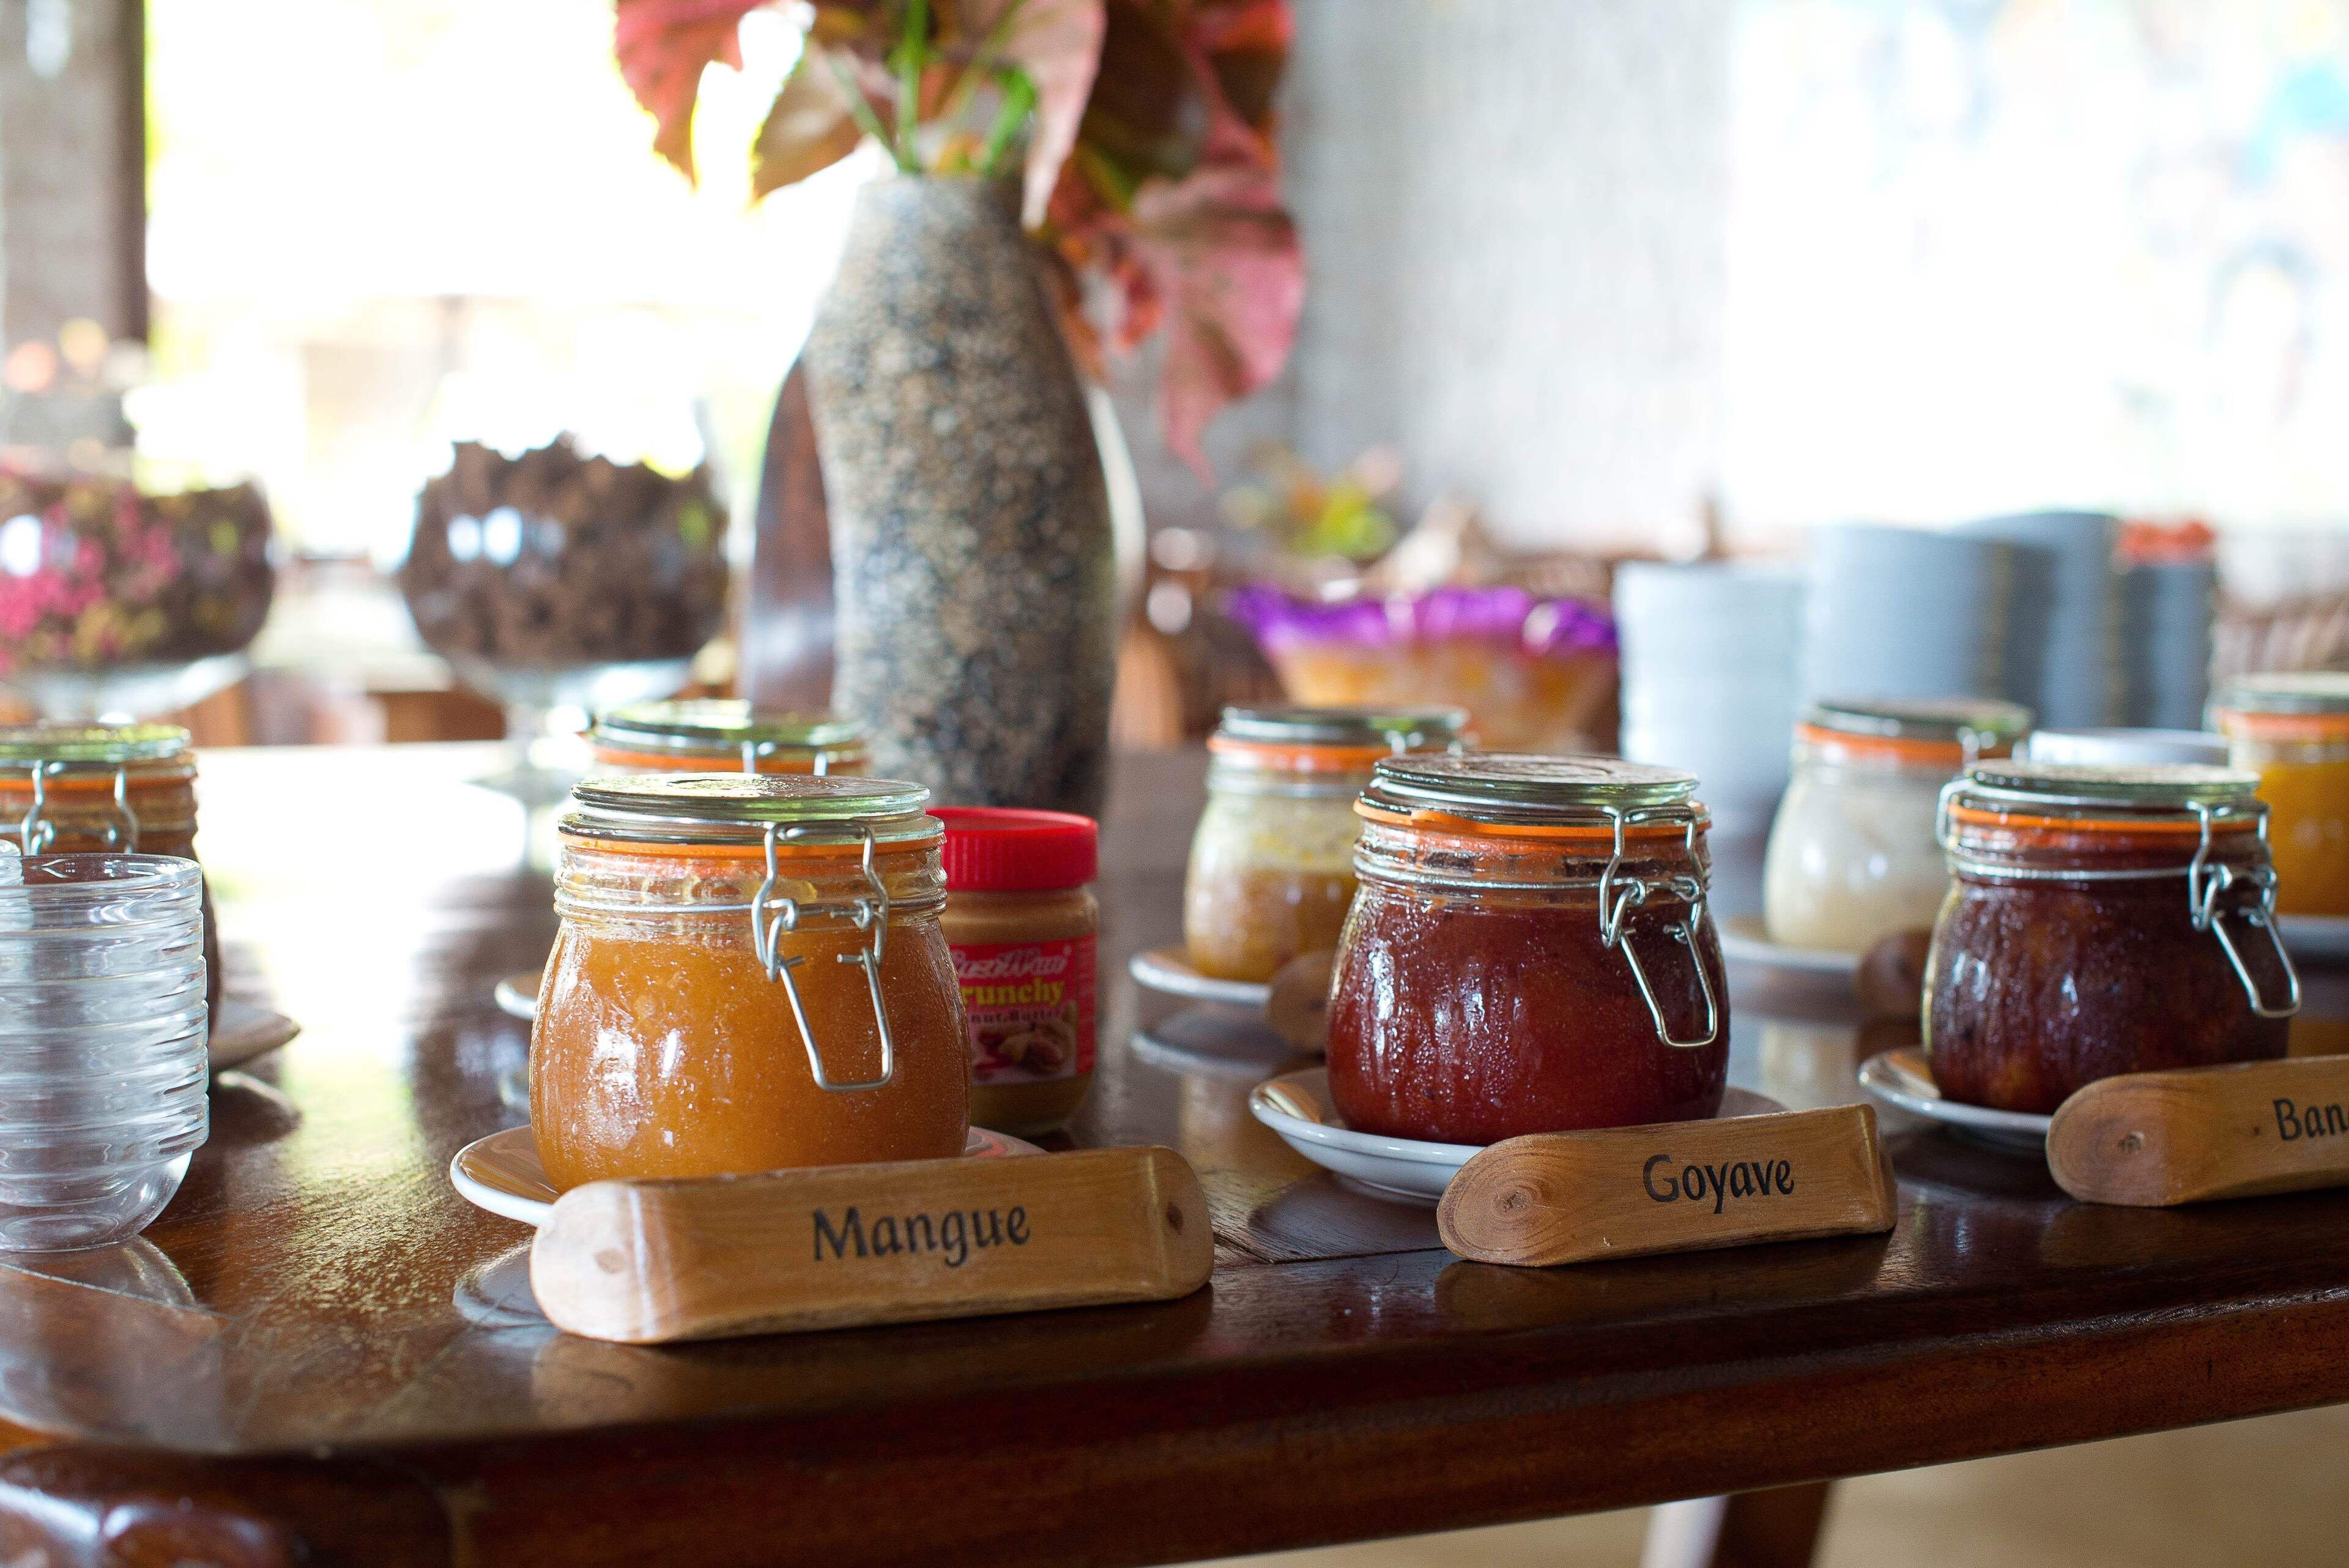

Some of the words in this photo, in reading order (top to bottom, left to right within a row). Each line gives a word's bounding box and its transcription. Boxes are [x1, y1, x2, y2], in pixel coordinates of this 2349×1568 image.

[961, 977, 1065, 1008] runchy
[2272, 1098, 2349, 1140] Ban
[1643, 1154, 1795, 1214] Goyave
[813, 1206, 1030, 1267] Mangue
